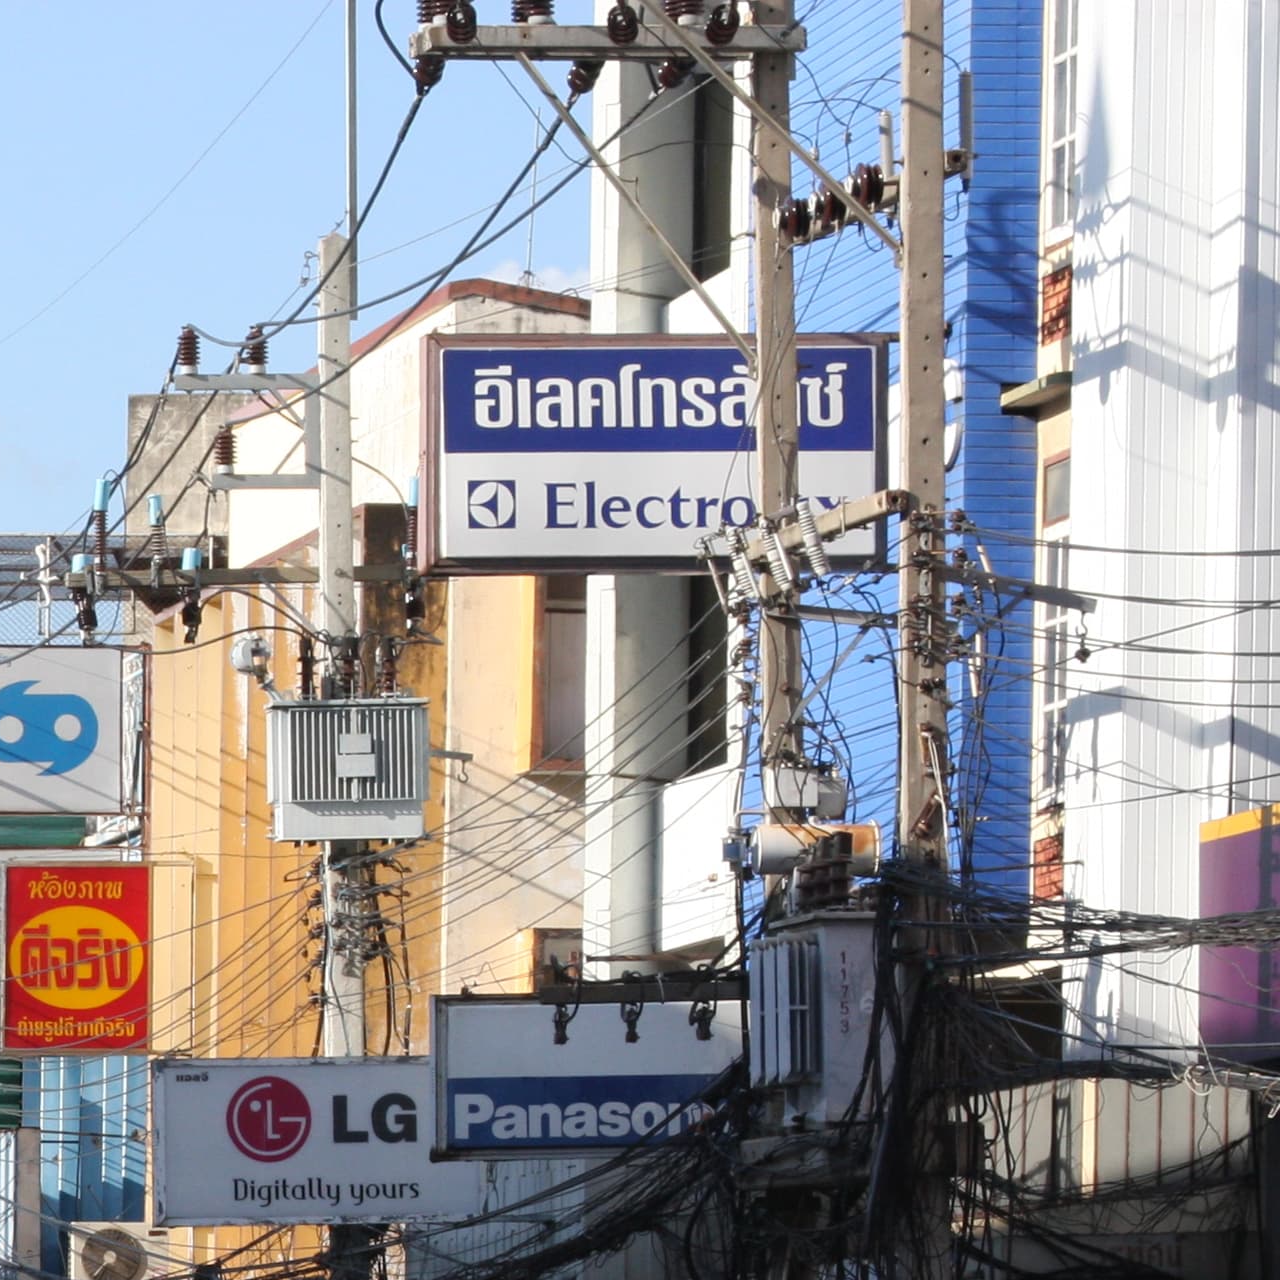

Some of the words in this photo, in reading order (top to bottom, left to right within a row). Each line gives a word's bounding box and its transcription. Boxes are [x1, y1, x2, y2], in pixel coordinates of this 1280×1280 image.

[28, 871, 123, 900] ห้องภาพ
[20, 924, 131, 990] ดีจริง
[333, 1093, 418, 1143] LG
[233, 1177, 340, 1208] Digitally
[350, 1181, 420, 1206] yours
